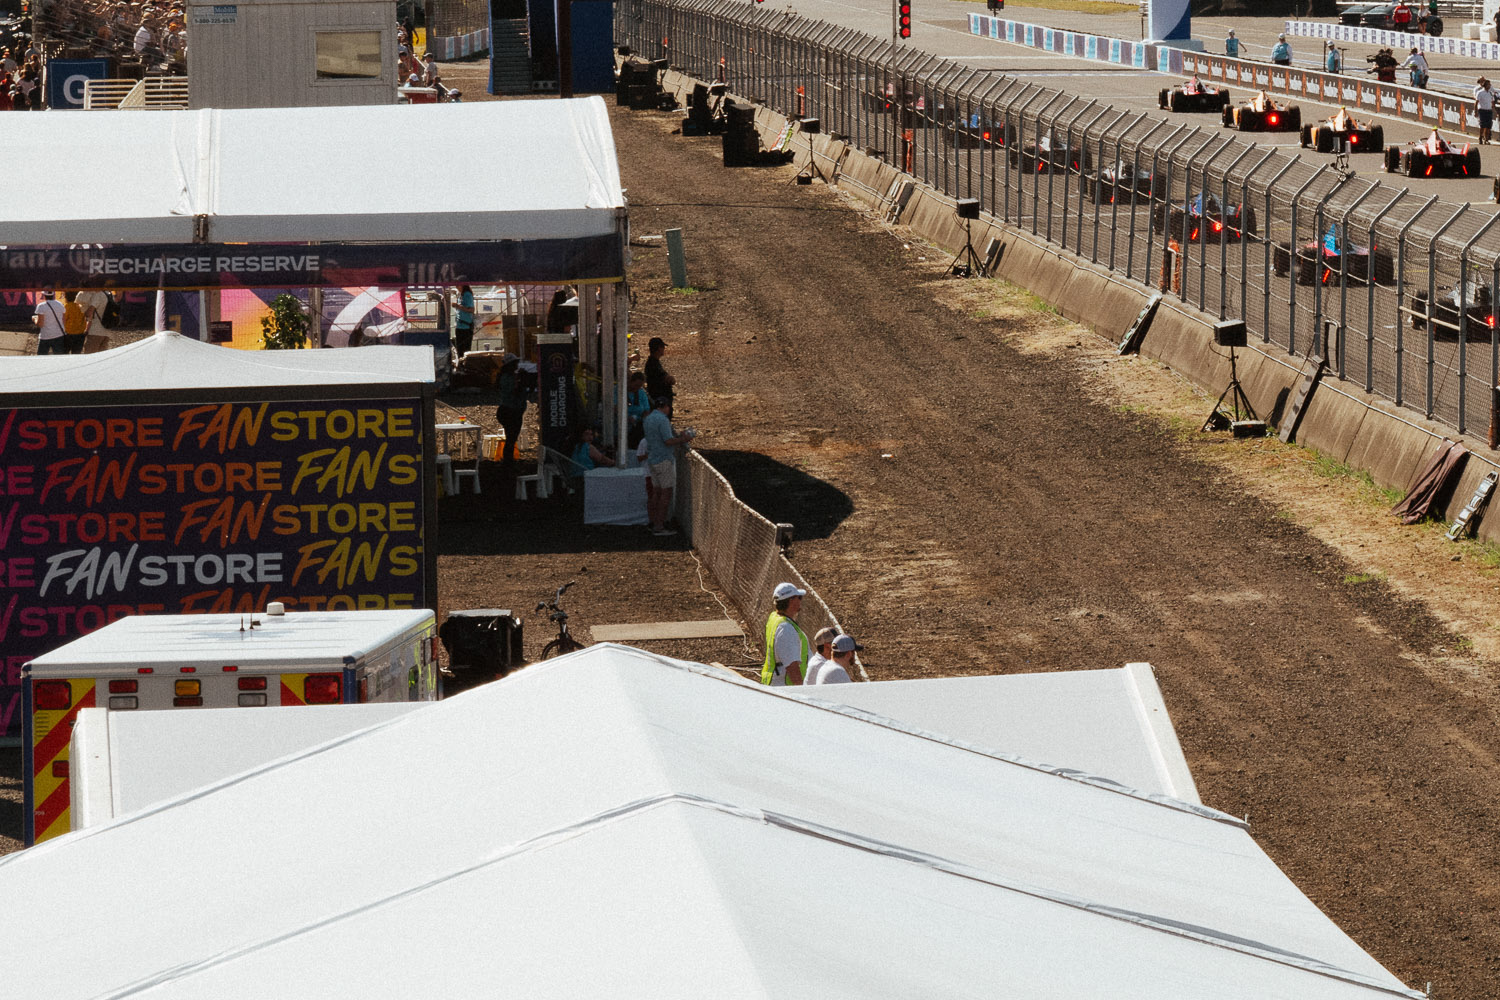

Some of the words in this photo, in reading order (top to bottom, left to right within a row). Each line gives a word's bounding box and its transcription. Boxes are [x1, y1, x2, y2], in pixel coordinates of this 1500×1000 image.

[89, 256, 212, 275] RECHARGE
[215, 255, 320, 272] RESERVE
[550, 390, 558, 427] MOBILE
[558, 375, 567, 427] CHARGING
[19, 418, 163, 450] STORE
[172, 403, 269, 454] FAN
[271, 408, 414, 441] STORE
[40, 451, 137, 508] FAN
[139, 461, 283, 495] STORE
[291, 442, 388, 499] FAN
[20, 512, 166, 545] STORE
[174, 493, 271, 549] FAN
[273, 501, 416, 536] STORE
[40, 543, 139, 600] FAN
[139, 552, 283, 586] STORE
[292, 534, 389, 590] FAN
